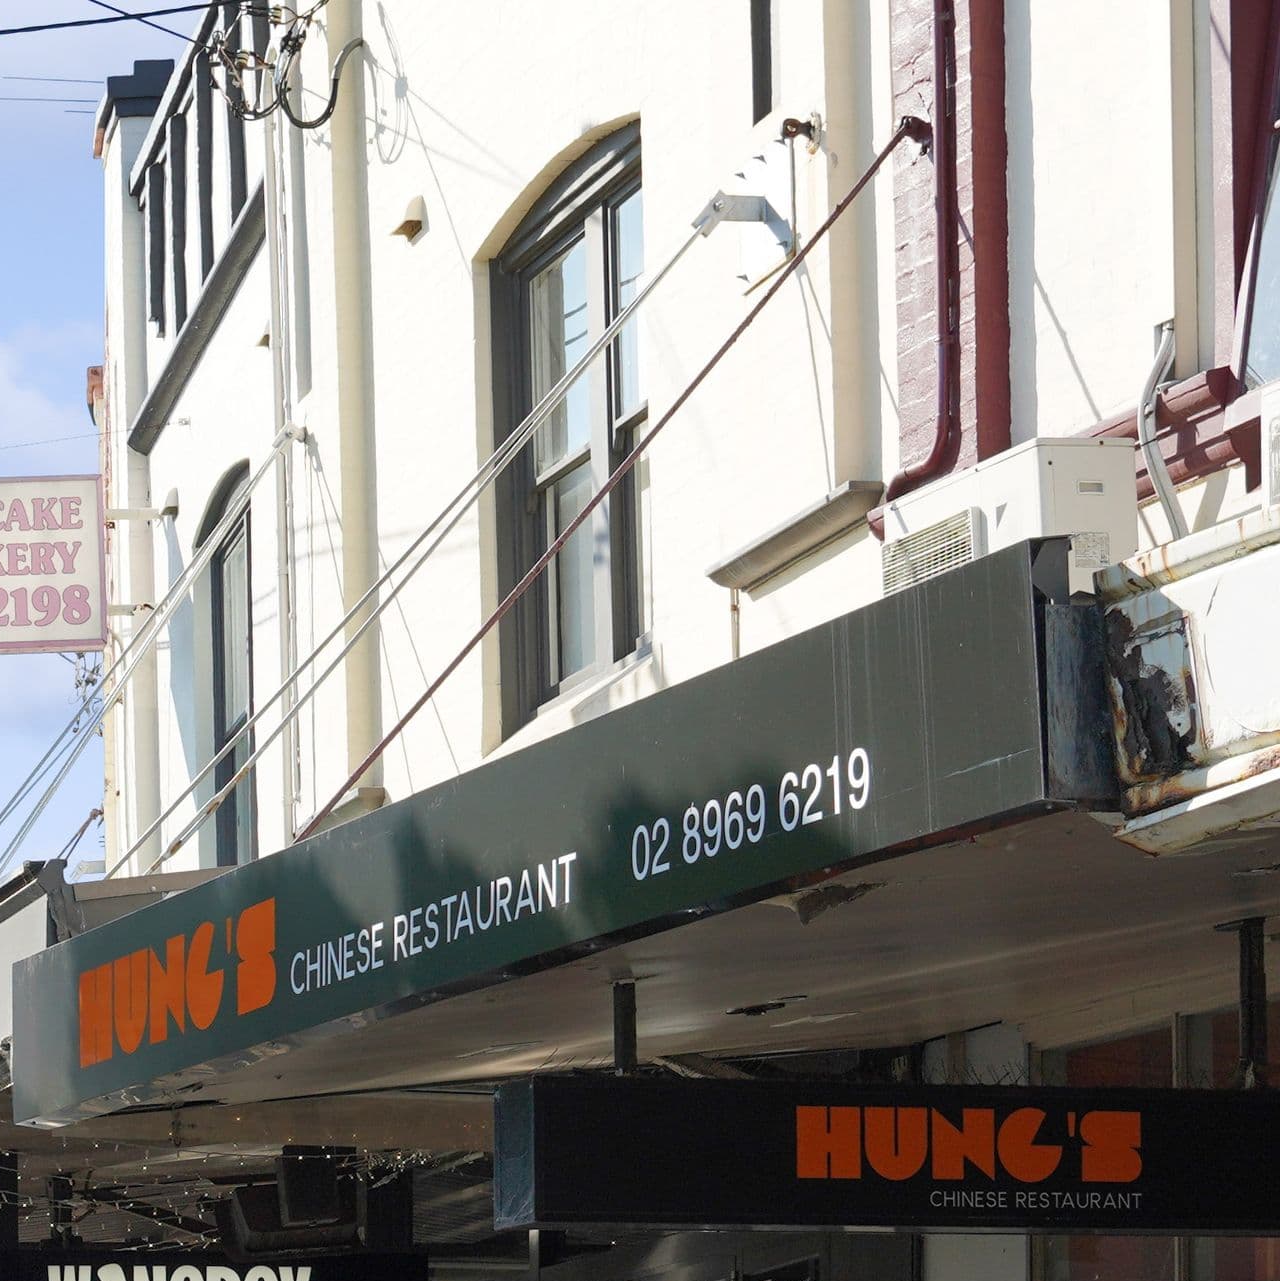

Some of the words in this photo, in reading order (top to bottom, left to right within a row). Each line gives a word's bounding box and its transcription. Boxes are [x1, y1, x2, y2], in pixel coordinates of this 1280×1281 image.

[631, 817, 670, 882] 02
[682, 783, 766, 867] 8969
[778, 747, 873, 834] 6219
[79, 897, 276, 1069] HUNG'S
[290, 923, 384, 996] CHINESE
[391, 852, 578, 960] RESTAURANT
[796, 1104, 1142, 1183] HUNG'S
[930, 1190, 1009, 1209] CHINESE
[1016, 1190, 1143, 1210] RESTAURANT
